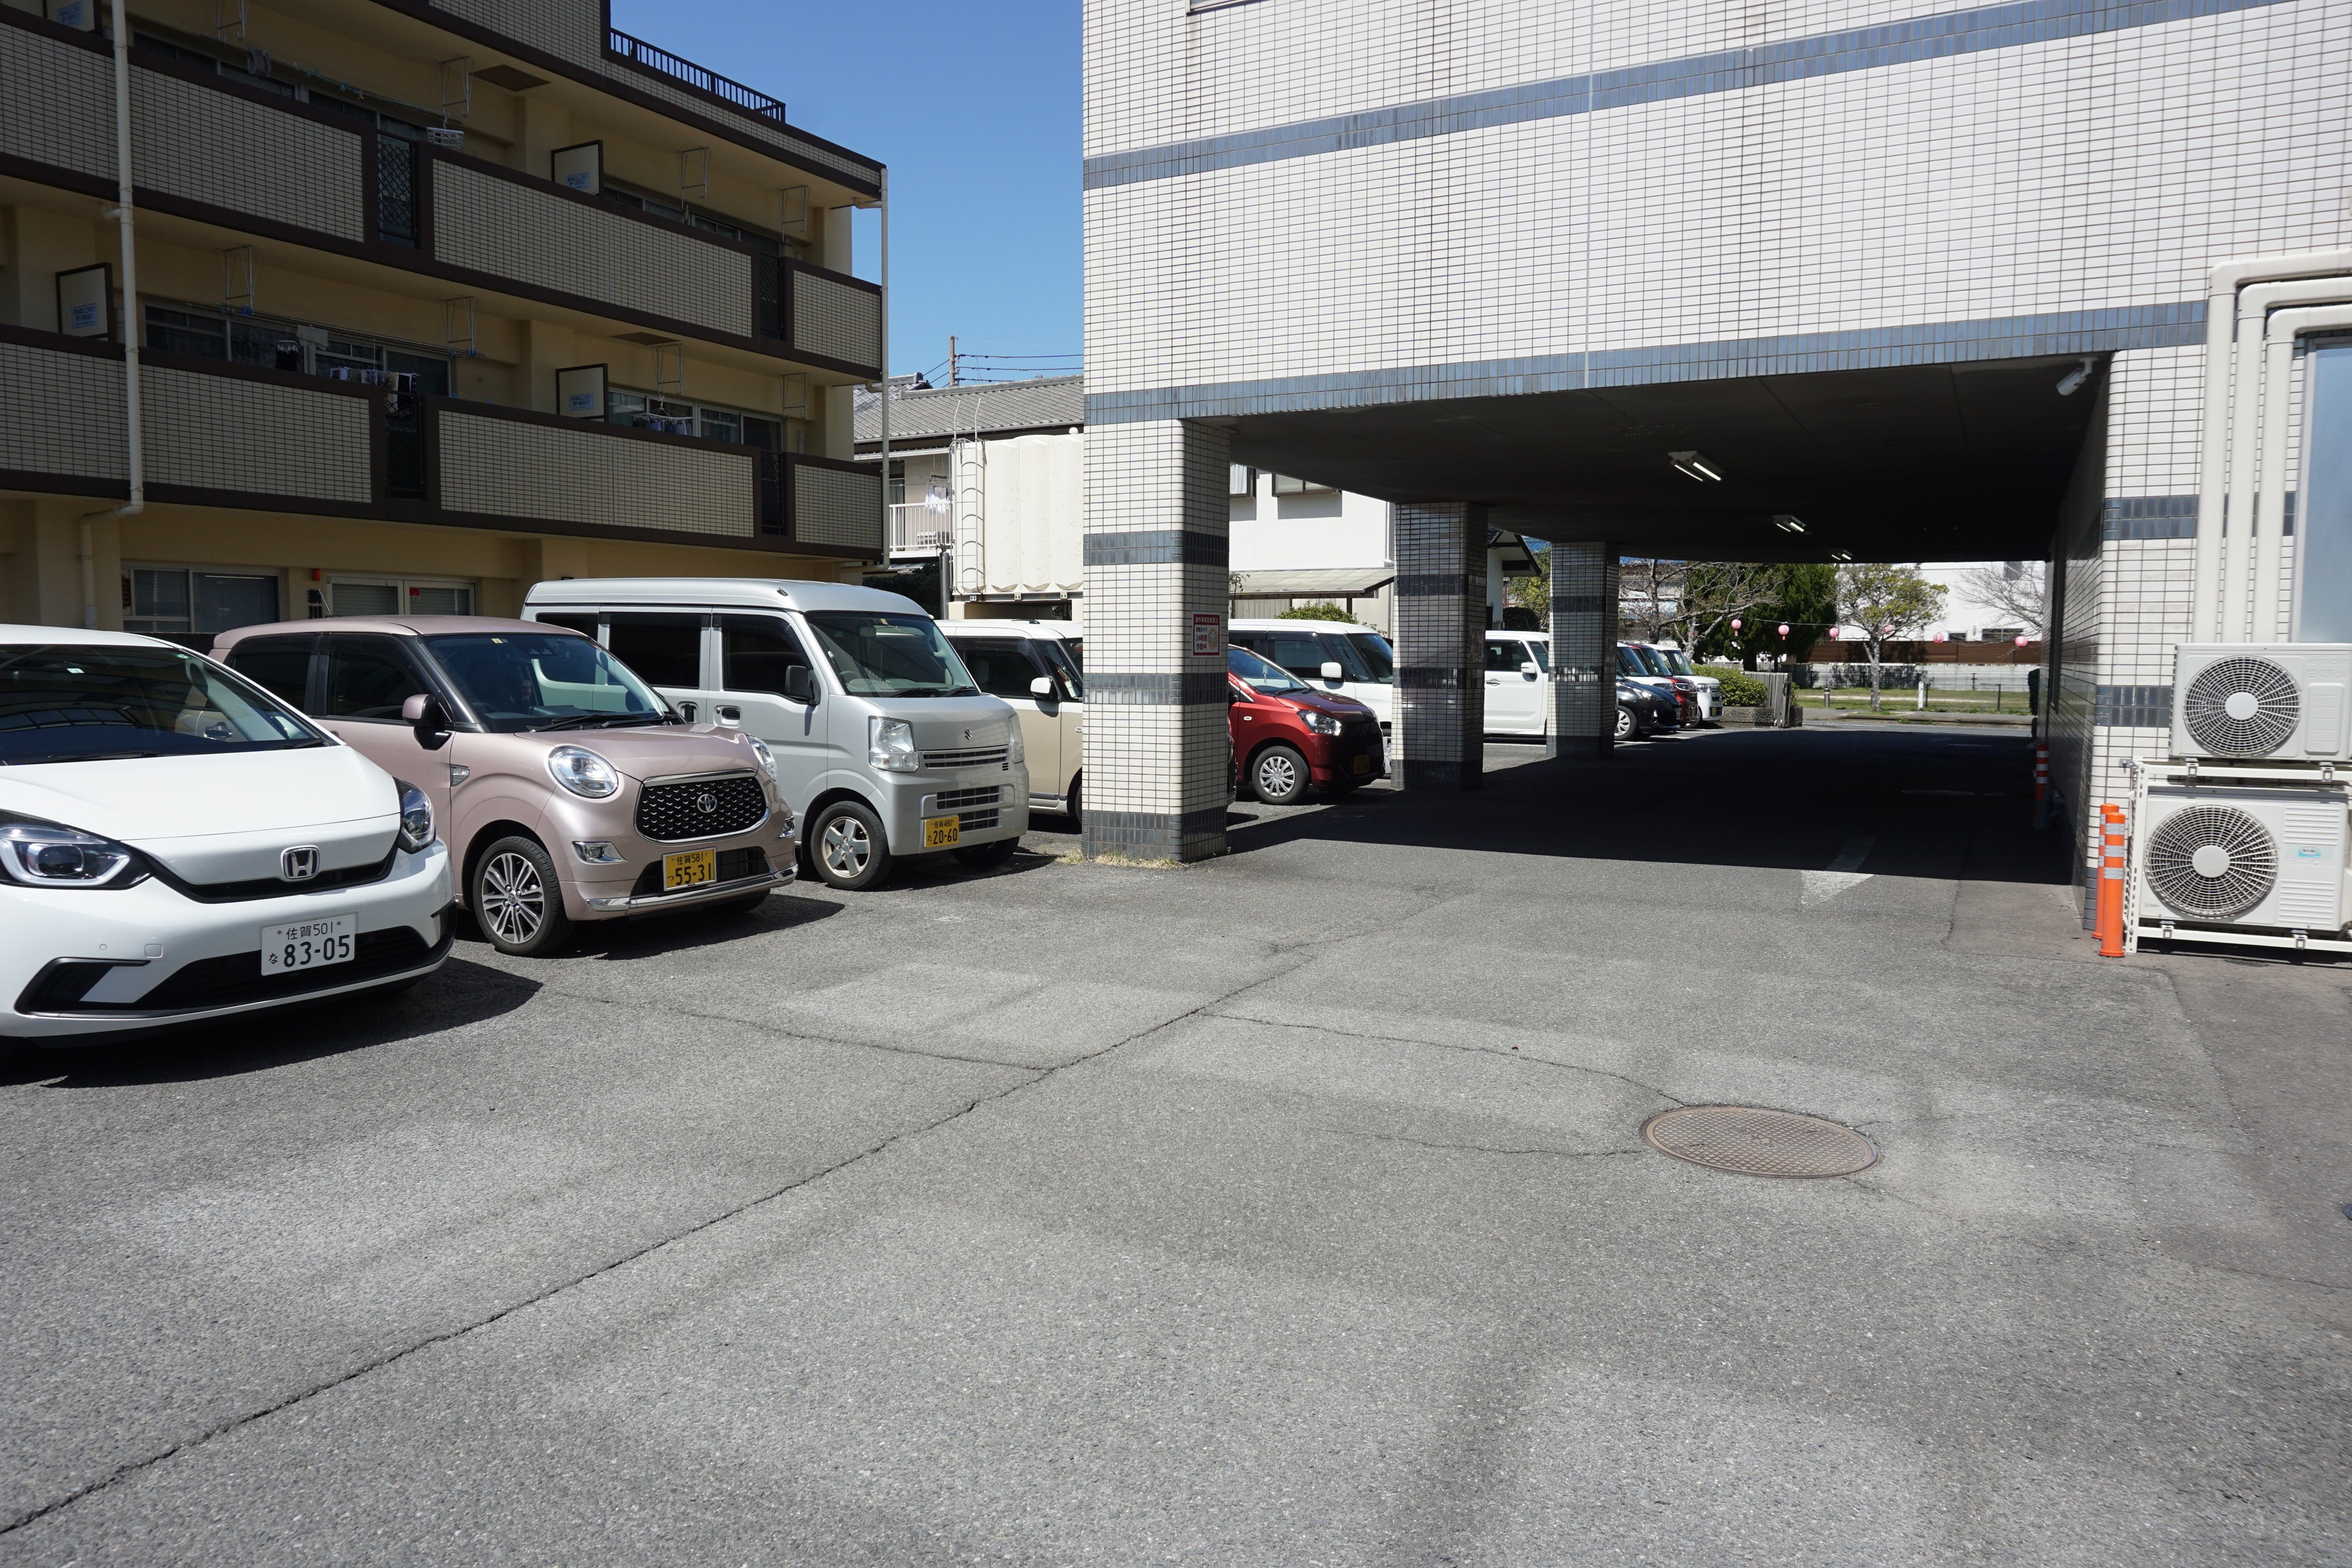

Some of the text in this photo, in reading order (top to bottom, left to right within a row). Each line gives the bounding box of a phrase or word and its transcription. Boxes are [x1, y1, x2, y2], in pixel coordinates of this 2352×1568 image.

[933, 827, 957, 845] 20-60
[675, 862, 711, 885] 55-31
[268, 934, 350, 968] な 83-05
